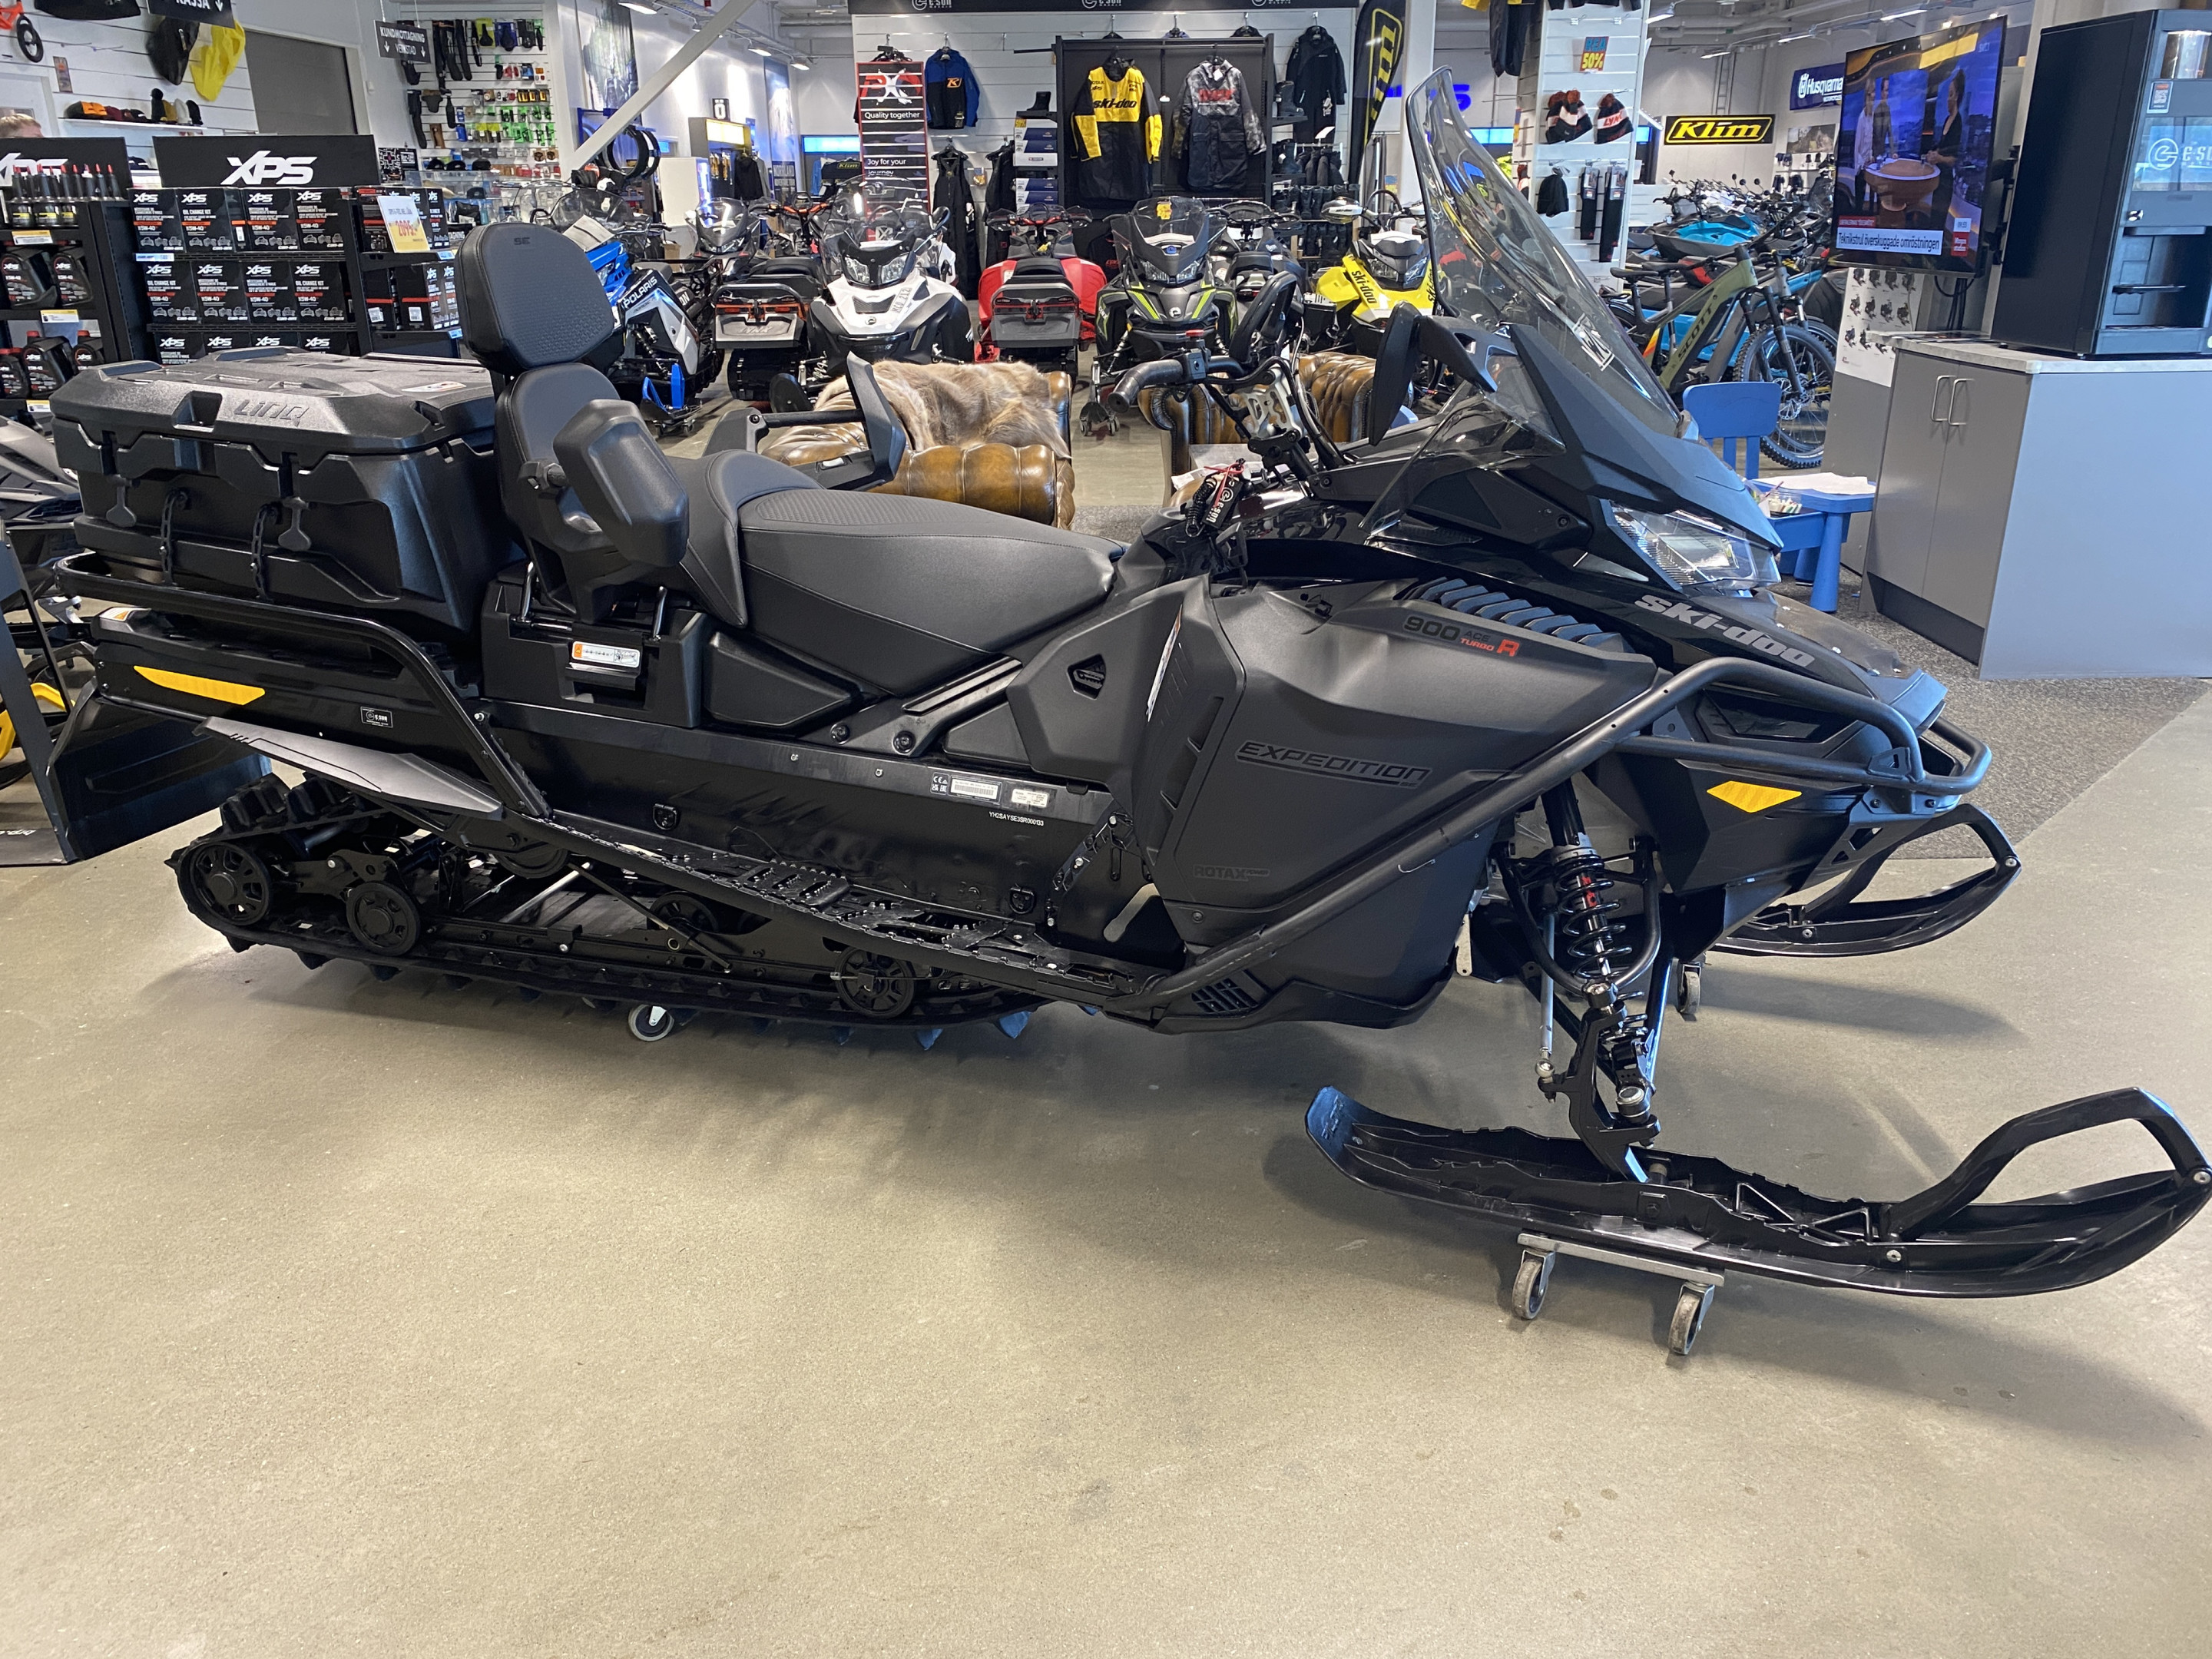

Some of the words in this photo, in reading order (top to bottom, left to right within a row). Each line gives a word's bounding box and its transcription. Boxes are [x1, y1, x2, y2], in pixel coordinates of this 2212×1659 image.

[379, 26, 426, 43] KUNDMOTTAGNING
[395, 43, 416, 55] VERKSTAD
[1585, 38, 1607, 52] REA
[1582, 52, 1604, 69] 50%
[1806, 78, 1843, 96] Husqvarna
[714, 99, 727, 120] Ö
[889, 111, 920, 120] together
[1672, 121, 1762, 139] Klim
[220, 151, 317, 185] XPS
[133, 192, 159, 203] XPS
[181, 192, 207, 203] XPS
[247, 192, 273, 203] XPS
[296, 190, 323, 201] XPS
[514, 237, 531, 246] SE
[1839, 233, 1863, 246] Teknikstrul
[1865, 233, 1899, 250] överskuggade
[1900, 236, 1939, 253] omröstningen
[146, 264, 172, 274] XPS
[197, 264, 224, 274] XPS
[246, 264, 272, 275] XPS
[294, 264, 321, 274] XPS
[623, 276, 657, 309] POLARIS
[1352, 270, 1378, 304] ski-doo
[1678, 303, 1713, 361] SCOTT
[159, 337, 186, 347] XPS
[207, 336, 233, 346] XPS
[256, 336, 281, 346] XPS
[305, 336, 330, 347] XPS
[1404, 616, 1461, 641] 900
[1464, 631, 1492, 642] ACE
[1460, 637, 1495, 651] TURBO
[1496, 639, 1520, 657] R
[1239, 741, 1431, 780] EXPEDITION
[1194, 866, 1247, 880] ROTAX
